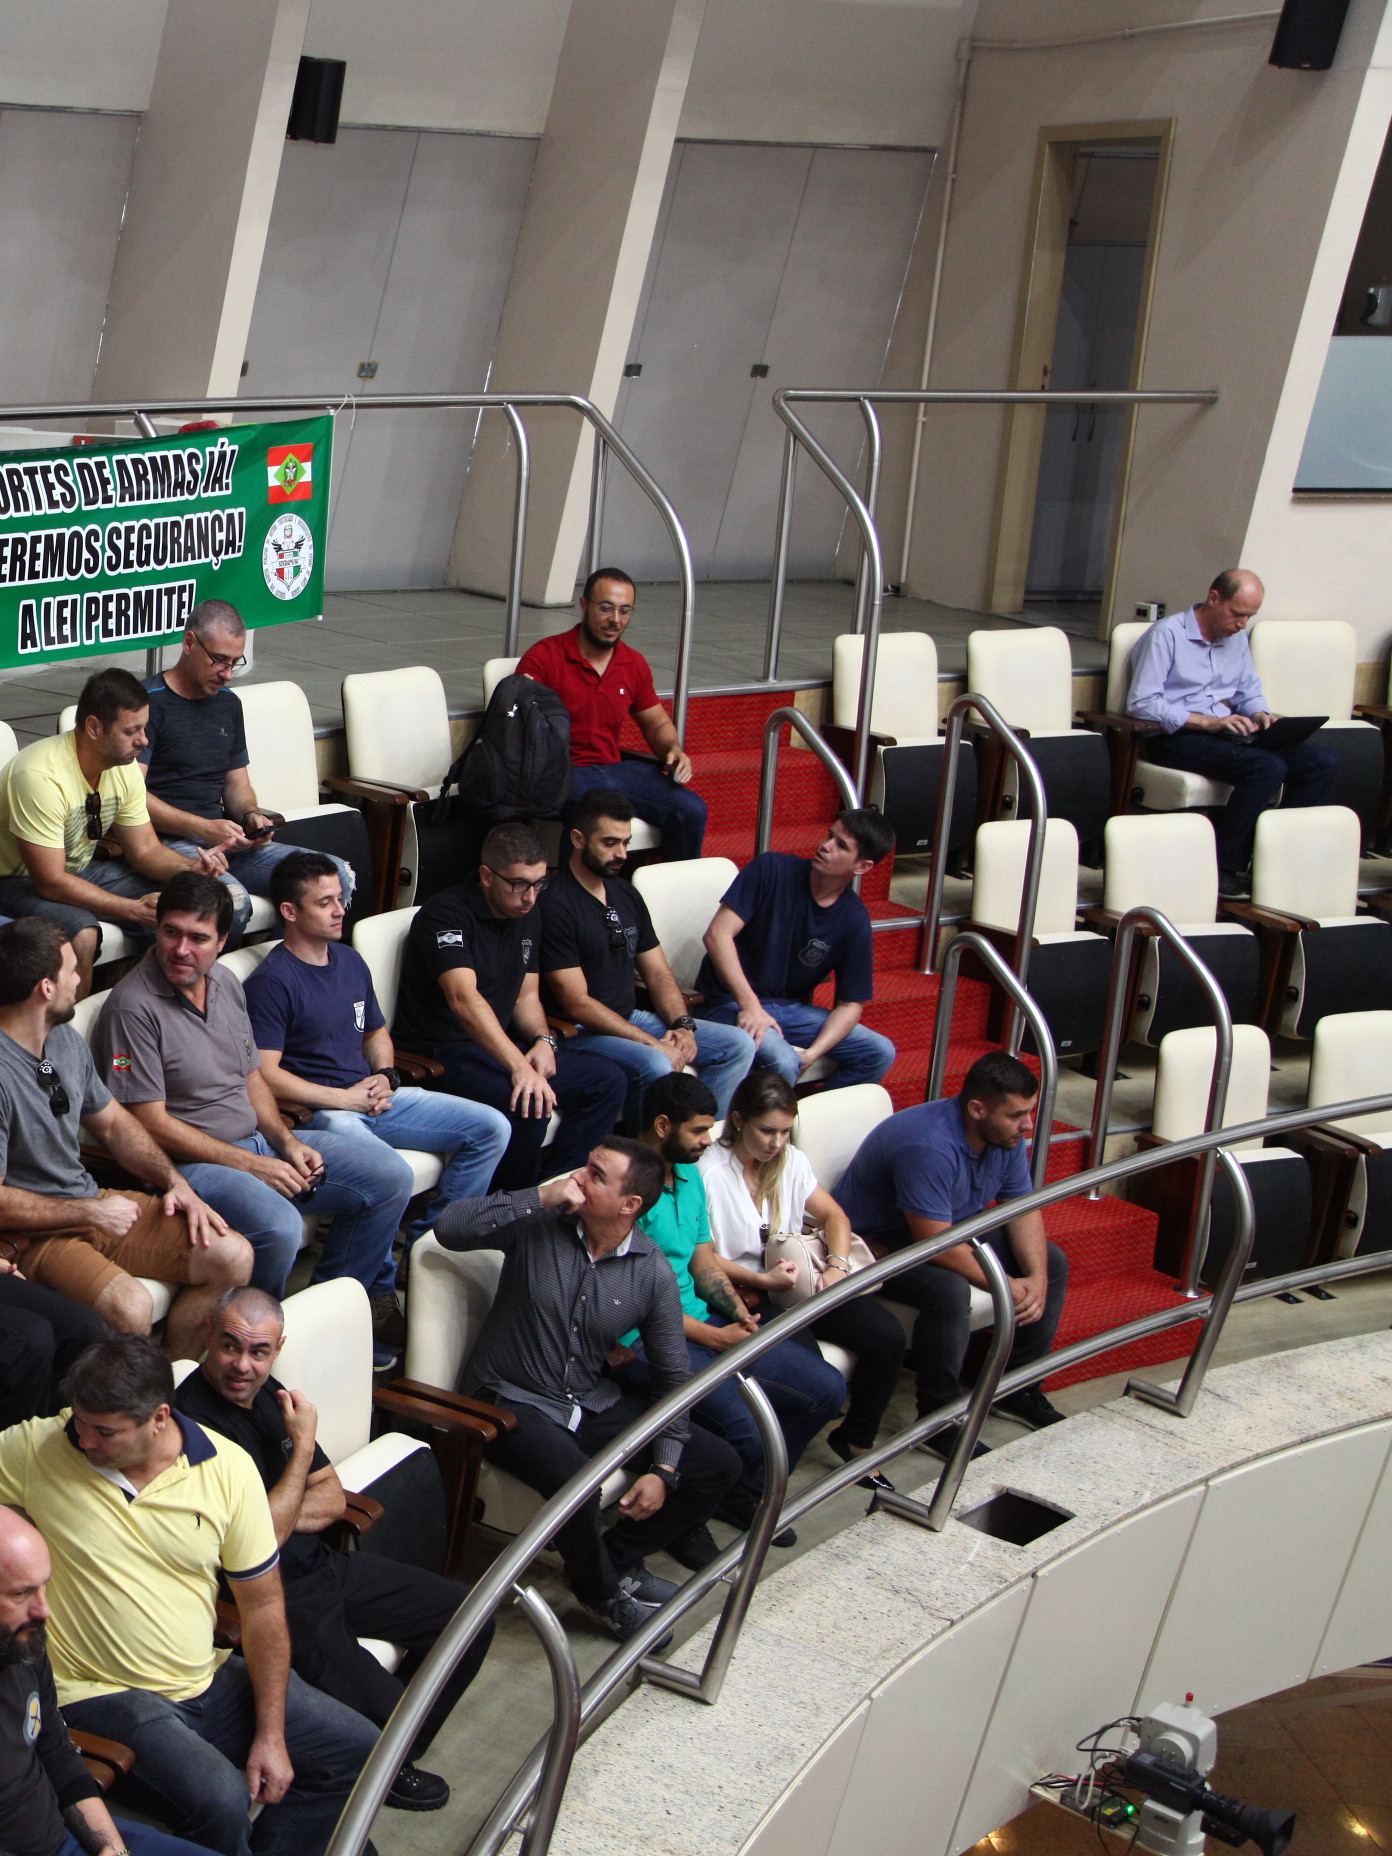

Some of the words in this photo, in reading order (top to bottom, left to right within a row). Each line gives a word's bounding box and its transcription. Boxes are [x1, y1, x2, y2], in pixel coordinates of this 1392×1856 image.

[76, 459, 116, 508] DE
[116, 449, 202, 503] ARMAS
[202, 439, 238, 494] JÁ!
[106, 510, 245, 568] SEGURANÇA!
[20, 602, 39, 651] A
[43, 595, 79, 648] LEI
[85, 582, 196, 642] PERMITE!
